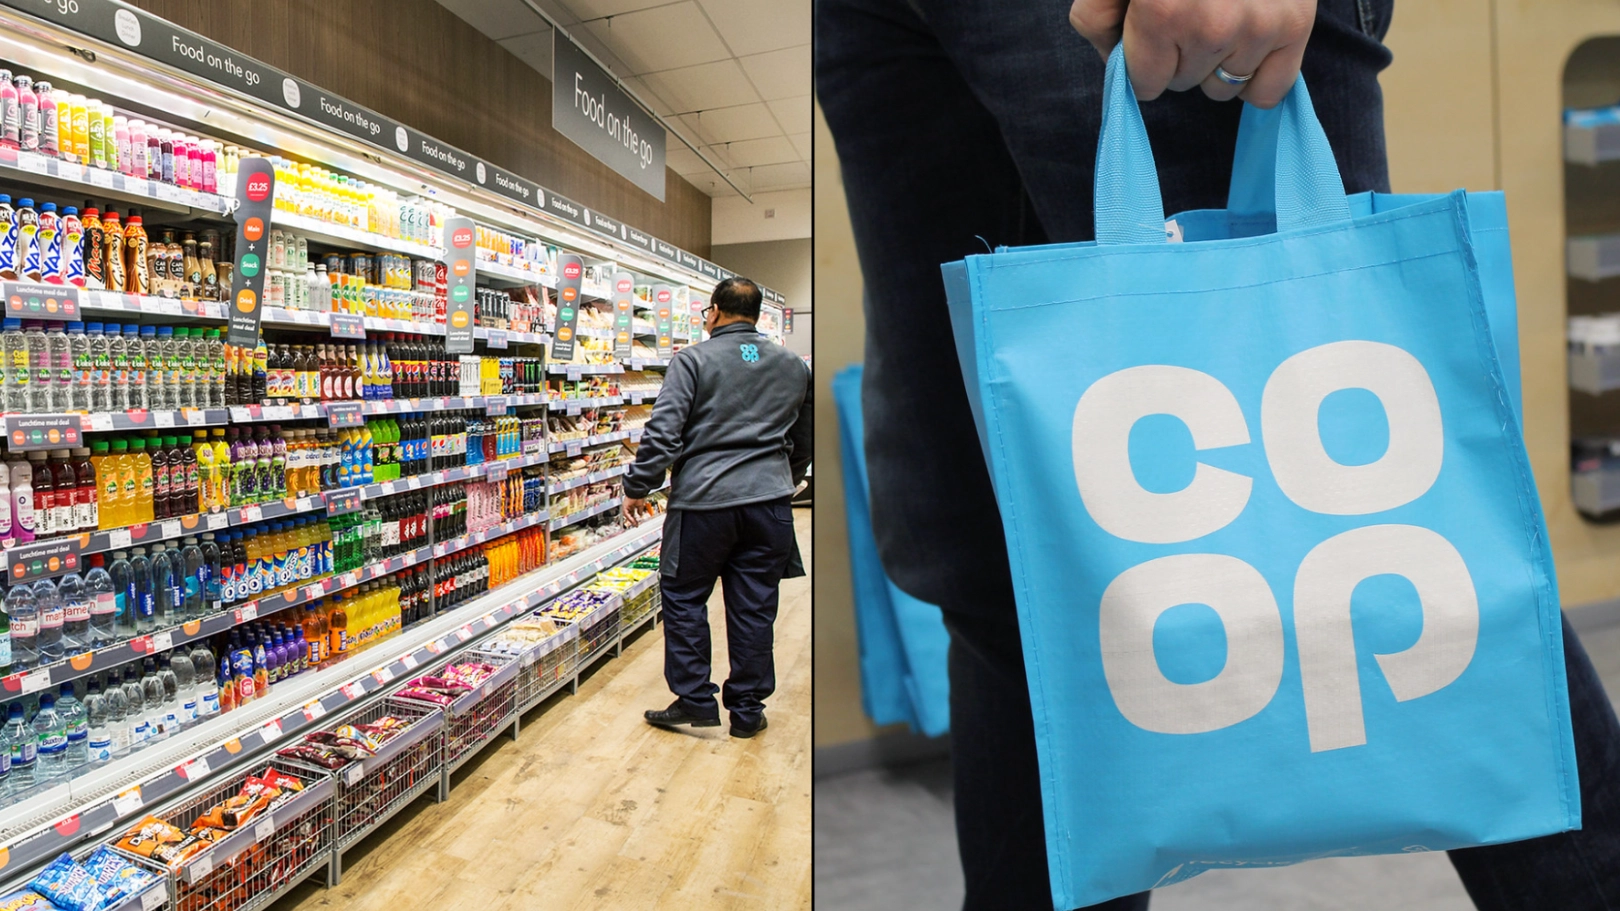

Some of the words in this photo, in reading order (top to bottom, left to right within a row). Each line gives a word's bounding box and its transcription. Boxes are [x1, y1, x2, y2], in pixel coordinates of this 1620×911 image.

[172, 35, 204, 62] Food
[207, 54, 222, 70] on
[224, 58, 243, 78] the
[245, 70, 260, 85] go
[320, 97, 343, 119] Food
[344, 110, 355, 123] on
[355, 113, 369, 128] the
[370, 122, 380, 134] go
[575, 72, 604, 129] Food
[607, 112, 620, 141] on
[623, 115, 638, 154] the
[640, 139, 653, 169] go
[422, 141, 438, 159] Food
[438, 151, 447, 162] on
[447, 152, 457, 166] the
[457, 159, 465, 171] go
[248, 182, 268, 192] £3.25
[495, 173, 508, 188] Food
[508, 182, 515, 190] on
[515, 182, 523, 194] the
[523, 187, 529, 198] go
[247, 225, 260, 233] Main
[454, 234, 470, 242] £3.25
[24, 228, 40, 272] YAZO
[67, 235, 85, 278] YAZO
[87, 229, 101, 279] Mars
[242, 261, 258, 269] Snack
[16, 286, 42, 294] Lunchtime
[239, 297, 253, 305] Drink
[233, 316, 256, 324] Lunchtime
[20, 550, 45, 559] Lunchtime
[46, 547, 58, 555] meal
[59, 545, 70, 553] deal
[42, 737, 65, 746] Buxton
